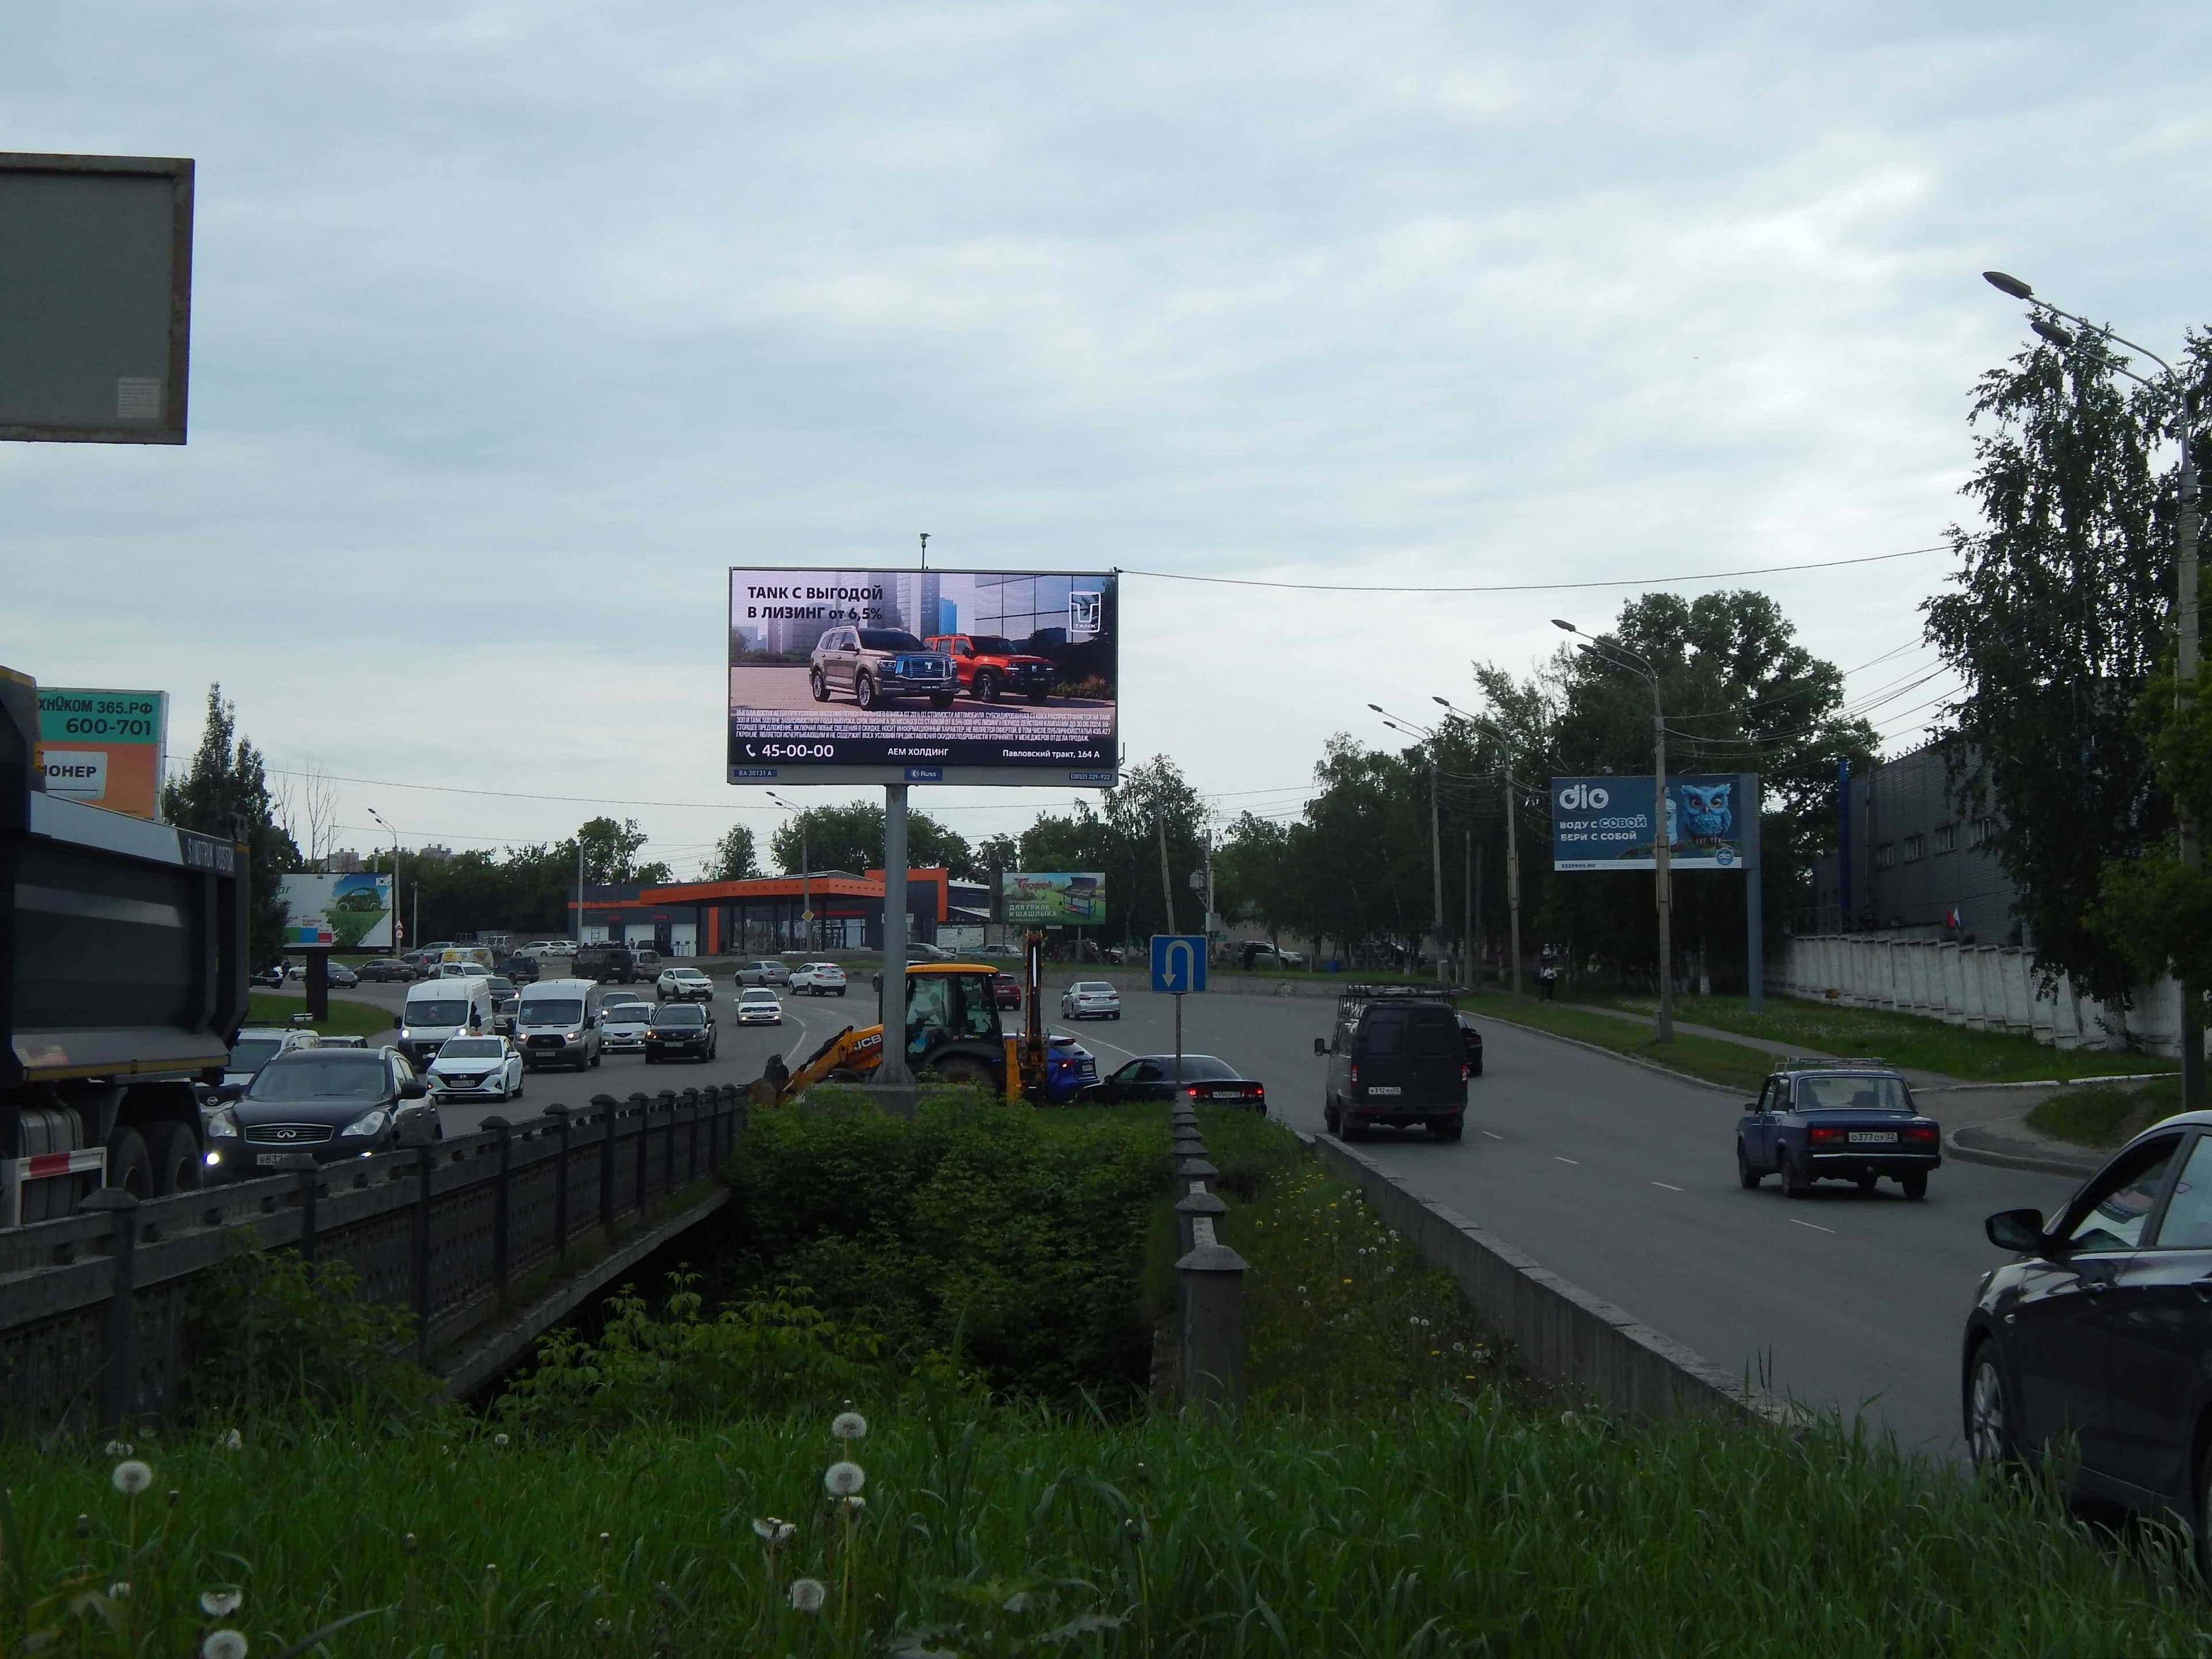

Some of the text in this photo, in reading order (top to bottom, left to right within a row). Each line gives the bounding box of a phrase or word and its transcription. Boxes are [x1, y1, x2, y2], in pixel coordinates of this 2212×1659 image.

[748, 585, 883, 602] TANK С ВЫГОДОЙ
[748, 607, 882, 621] В ЛИЗИНГ от 6,5%
[39, 696, 153, 714] ХНОКОМ 365.РФ
[66, 718, 150, 736] 600-701
[762, 744, 834, 757] 45-00-00
[908, 748, 949, 757] ХОЛДИНГ
[1003, 749, 1050, 757] Павловский
[1559, 784, 1609, 809] dio
[1560, 821, 1589, 830] ВОДУ
[1599, 814, 1647, 829] СОВОЙ
[1600, 831, 1637, 840] СОБОЙ
[854, 1034, 882, 1050] JCB
[260, 1154, 283, 1164] В832
